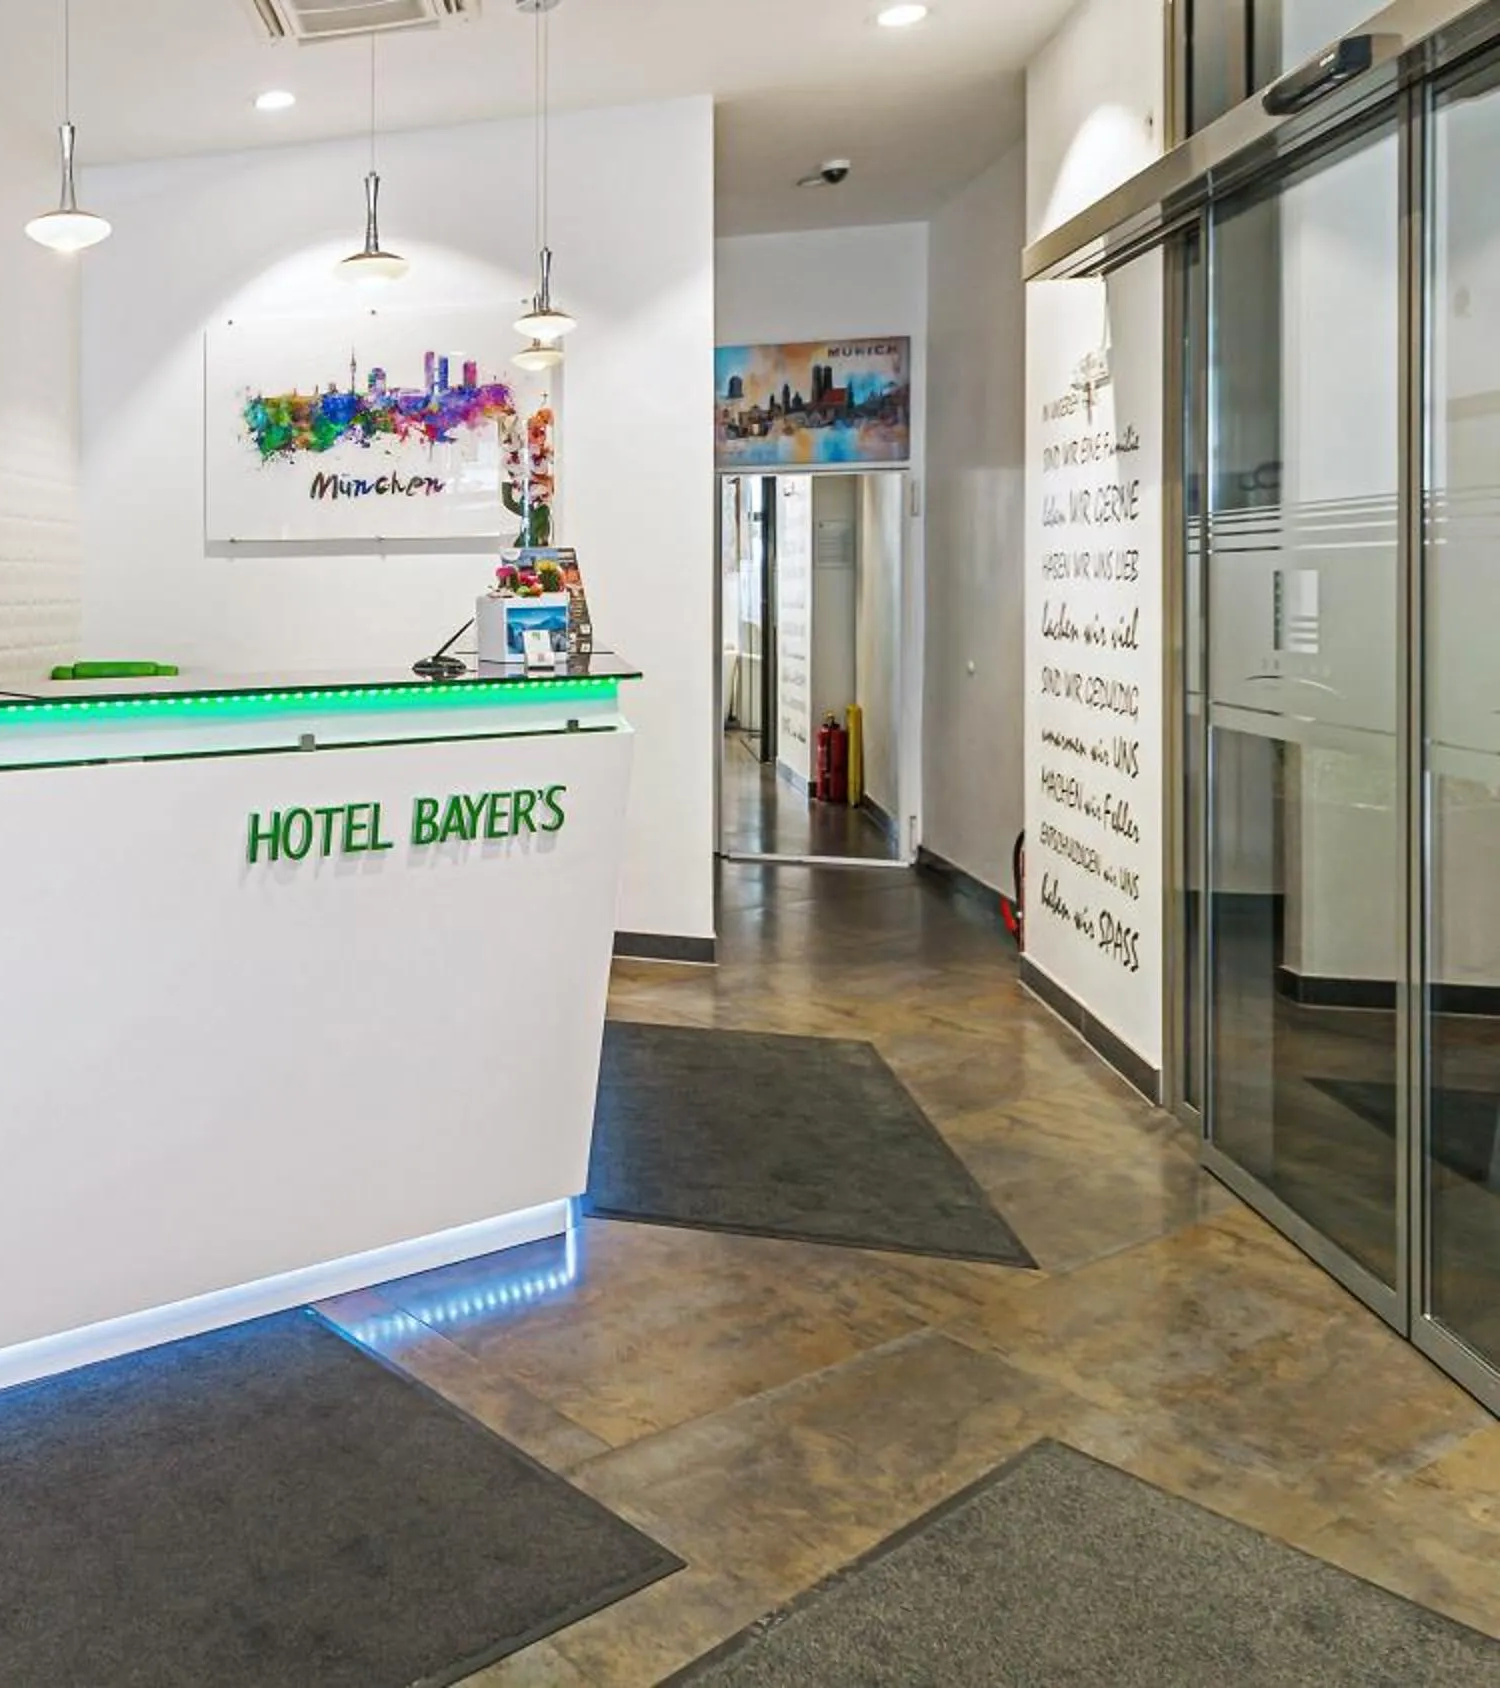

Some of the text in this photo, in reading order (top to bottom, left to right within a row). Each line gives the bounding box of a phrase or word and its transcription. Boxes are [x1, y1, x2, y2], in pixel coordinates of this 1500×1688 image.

[827, 346, 899, 358] MUNICH
[310, 469, 445, 501] München
[1094, 479, 1139, 524] GERNE
[1110, 607, 1139, 650] viel
[1112, 735, 1139, 779] UNS
[246, 785, 567, 864] HOTEL BAYER'S
[1119, 866, 1139, 901] UNS
[1073, 907, 1095, 939] wir
[1098, 908, 1139, 973] SPASS
